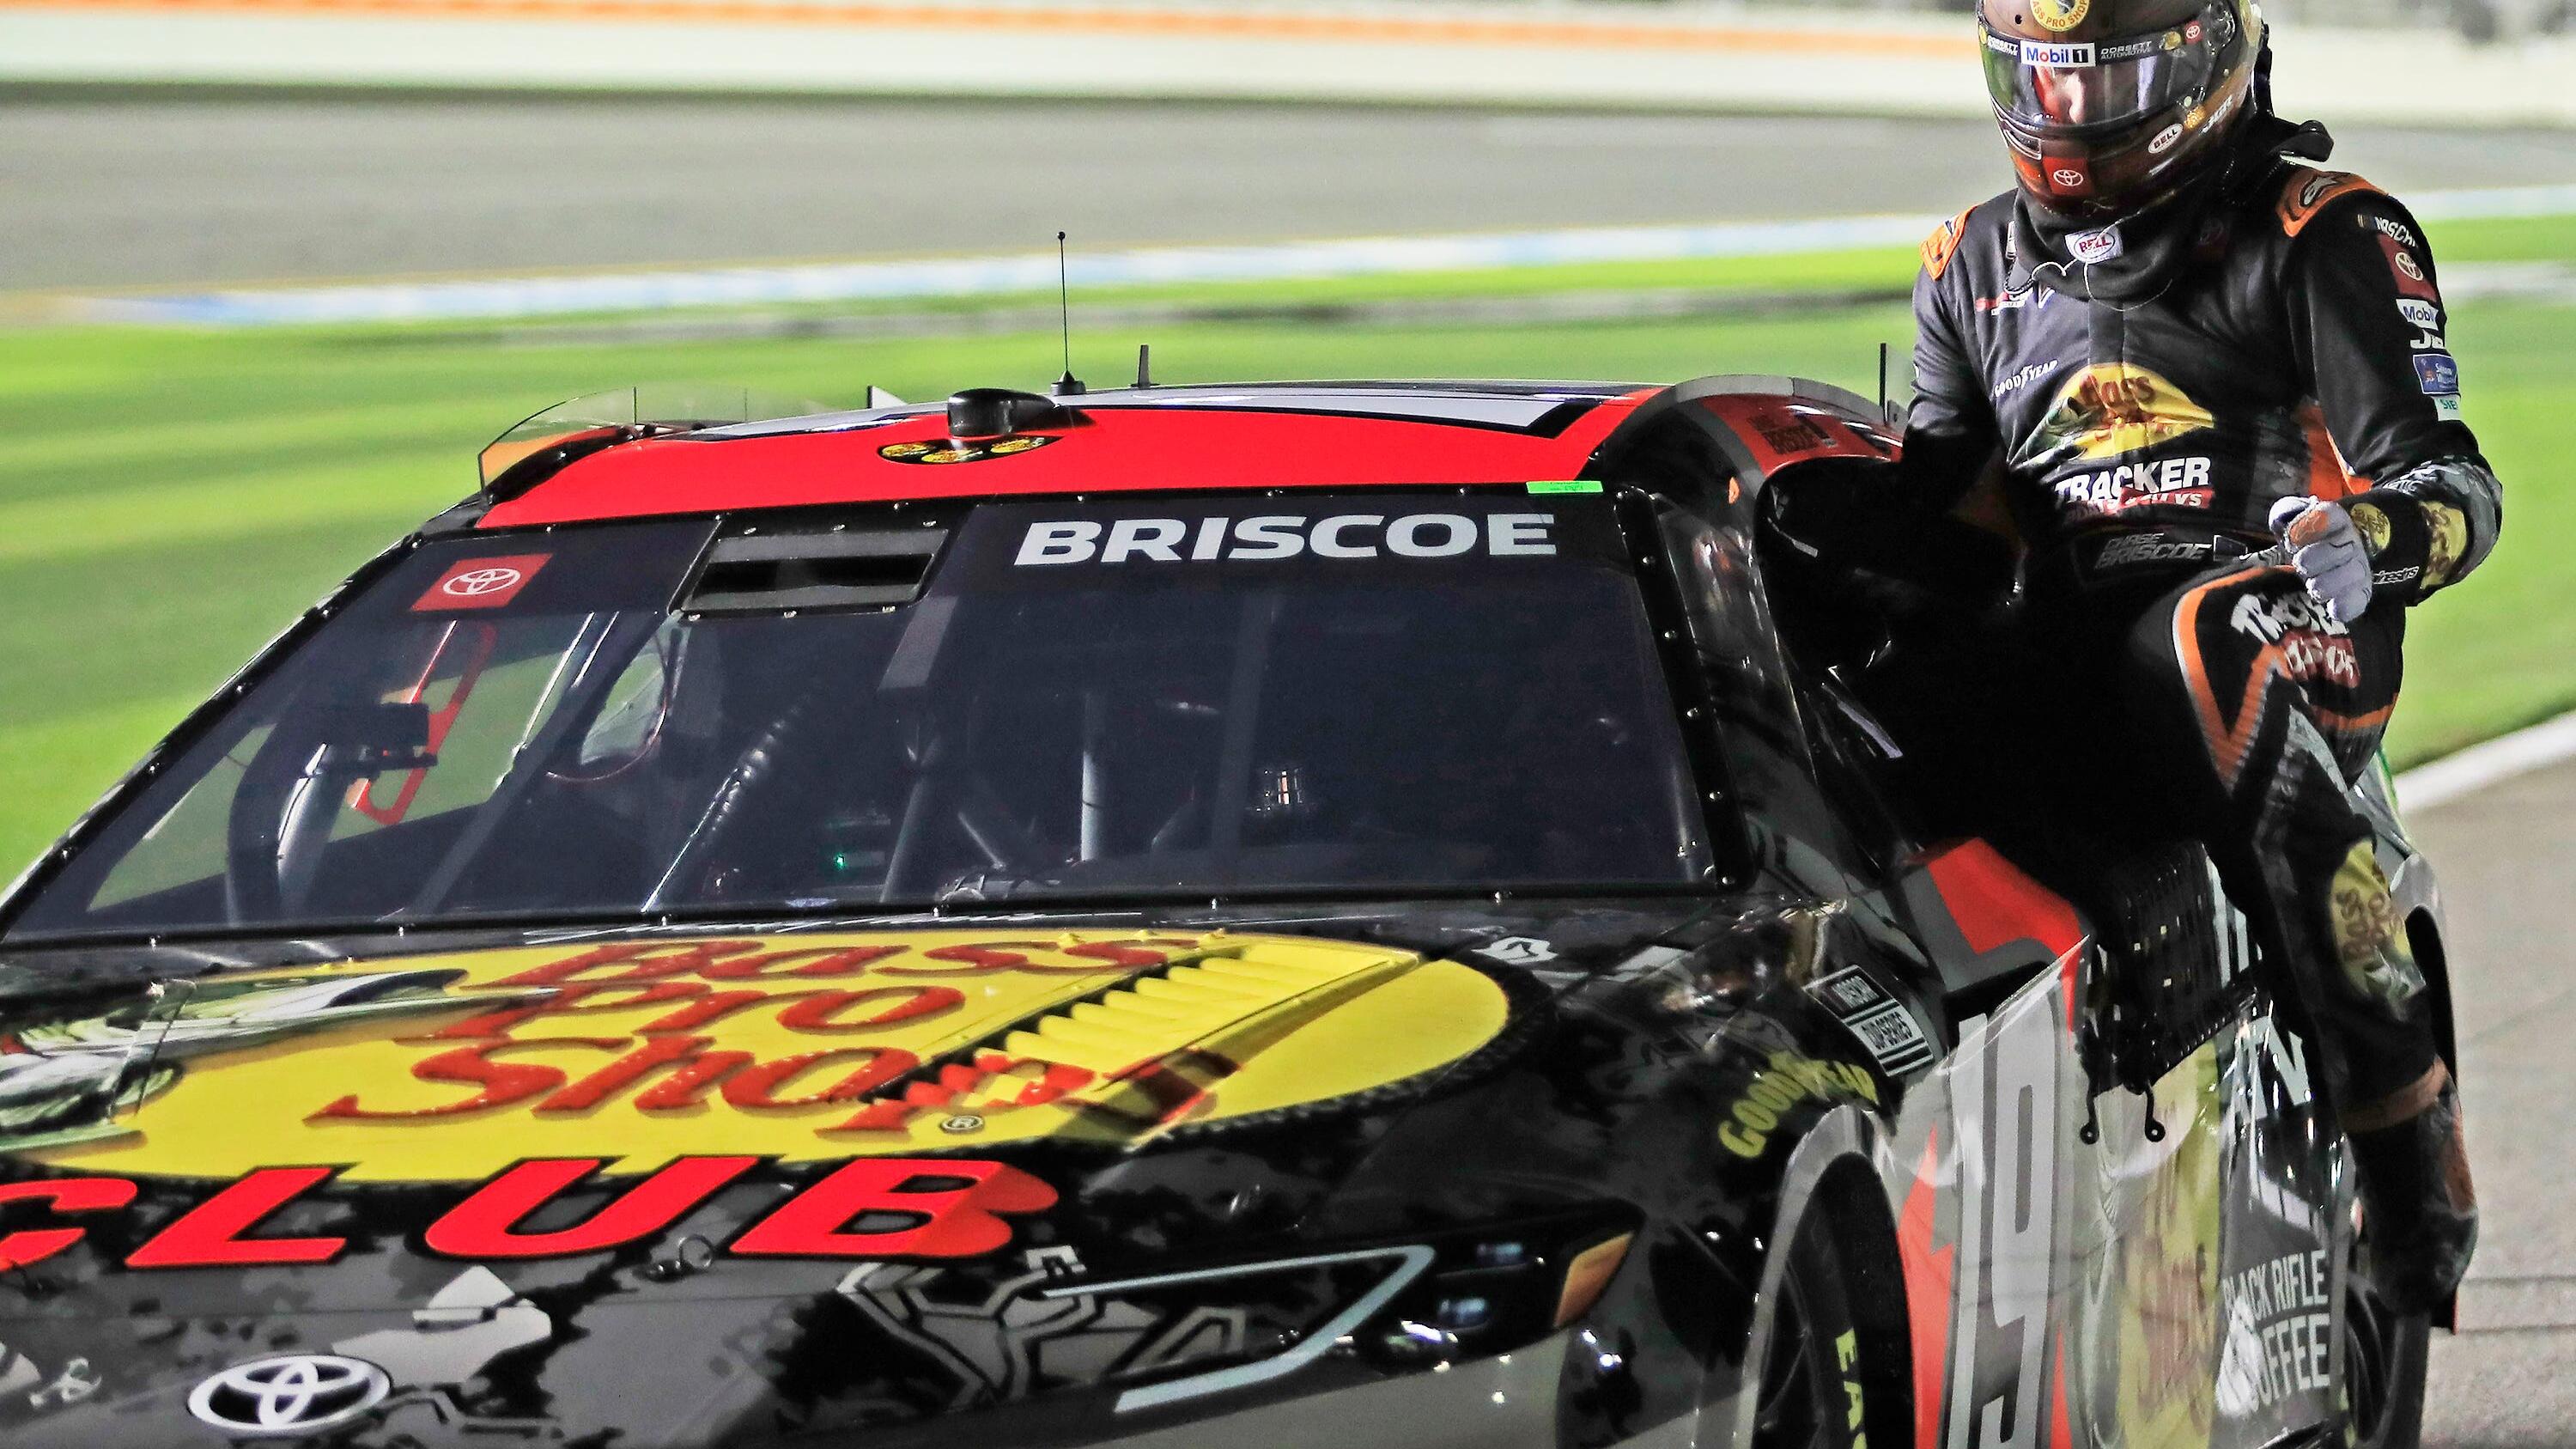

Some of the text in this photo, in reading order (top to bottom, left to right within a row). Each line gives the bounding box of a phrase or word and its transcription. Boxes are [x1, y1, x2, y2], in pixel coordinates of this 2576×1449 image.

[2046, 16, 2066, 27] PRO
[2026, 47, 2069, 63] Mobil
[2100, 41, 2152, 55] DORSETT
[2100, 47, 2152, 60] AUTOMOTIVE
[2154, 129, 2178, 149] BELL
[1994, 359, 2059, 398] GOODYEAR
[2054, 456, 2212, 504] TRACKER
[1014, 513, 1558, 567] BRISCOE
[465, 938, 1200, 991] Bass
[393, 980, 967, 1044] Pro
[2271, 1250, 2330, 1312] RIFLE
